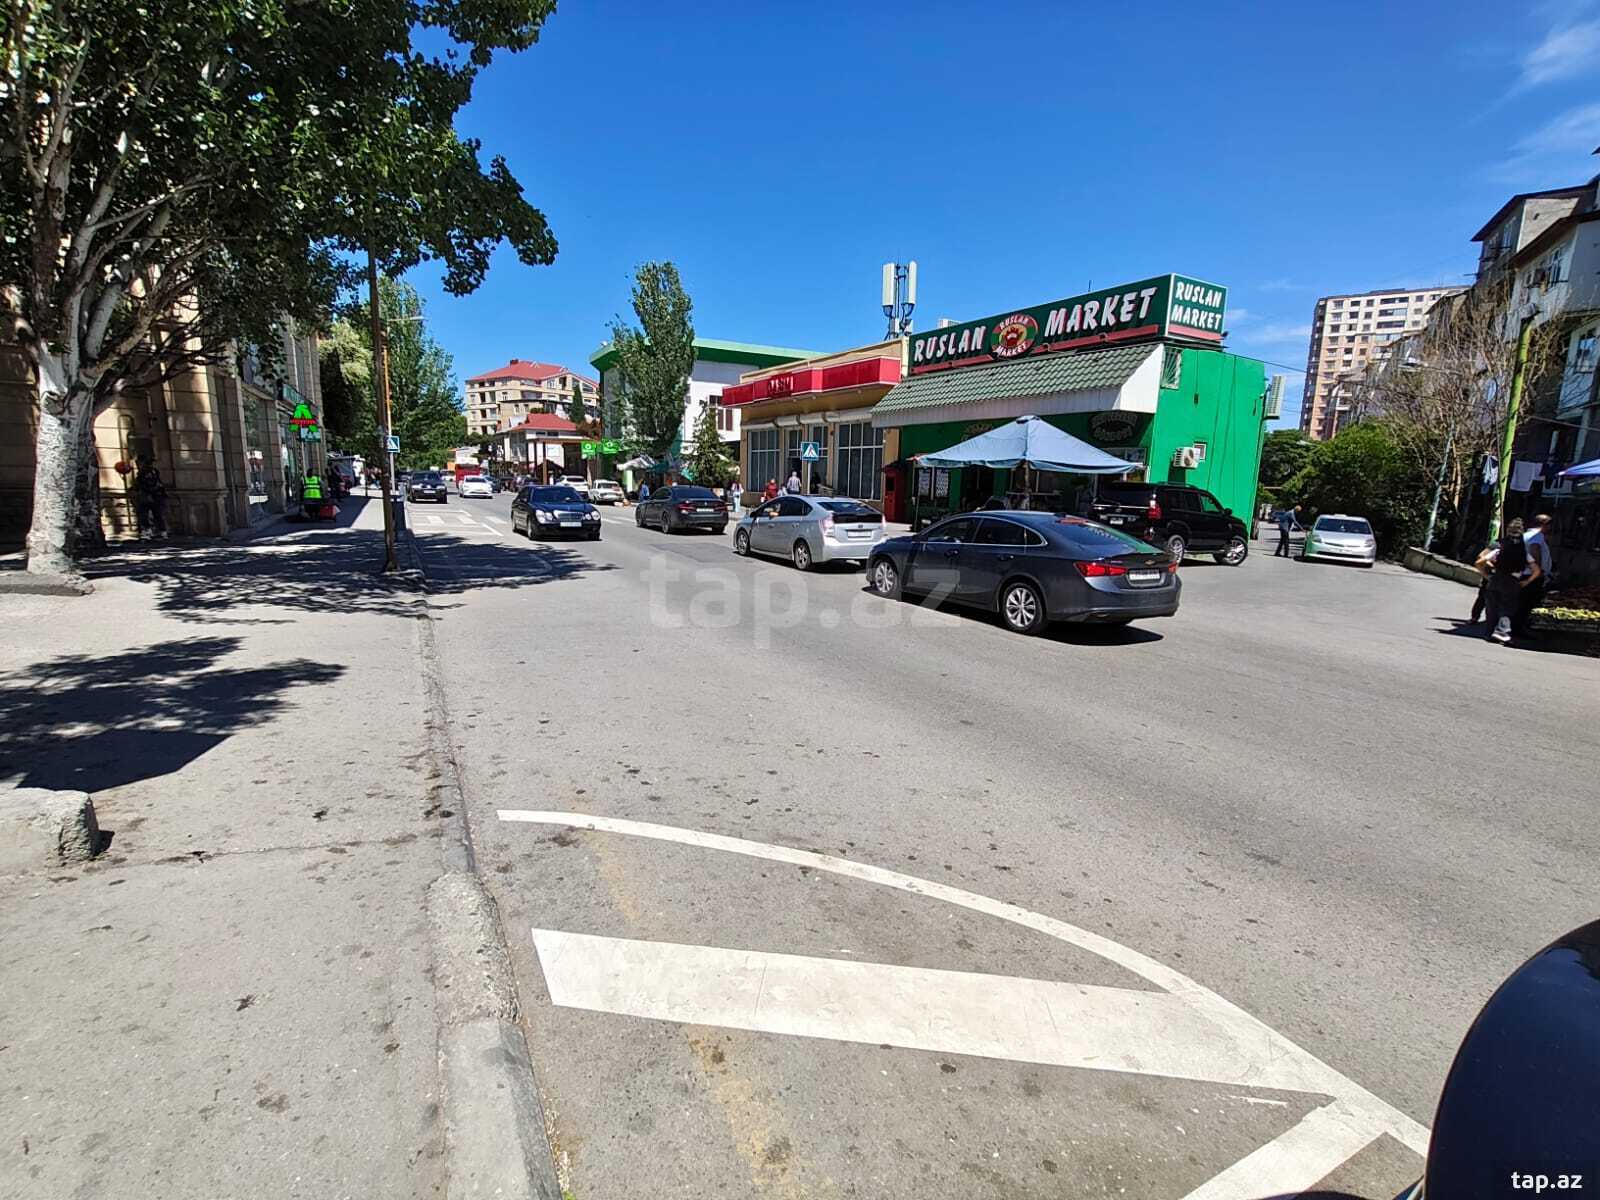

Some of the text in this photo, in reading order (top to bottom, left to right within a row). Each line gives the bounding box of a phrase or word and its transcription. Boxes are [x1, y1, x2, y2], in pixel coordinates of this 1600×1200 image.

[1175, 282, 1222, 308] RUSLAN
[914, 287, 1157, 362] RUSLAN MARKET
[999, 314, 1029, 330] RUSLAN
[1171, 305, 1222, 329] MARKET
[996, 341, 1026, 357] MARKET
